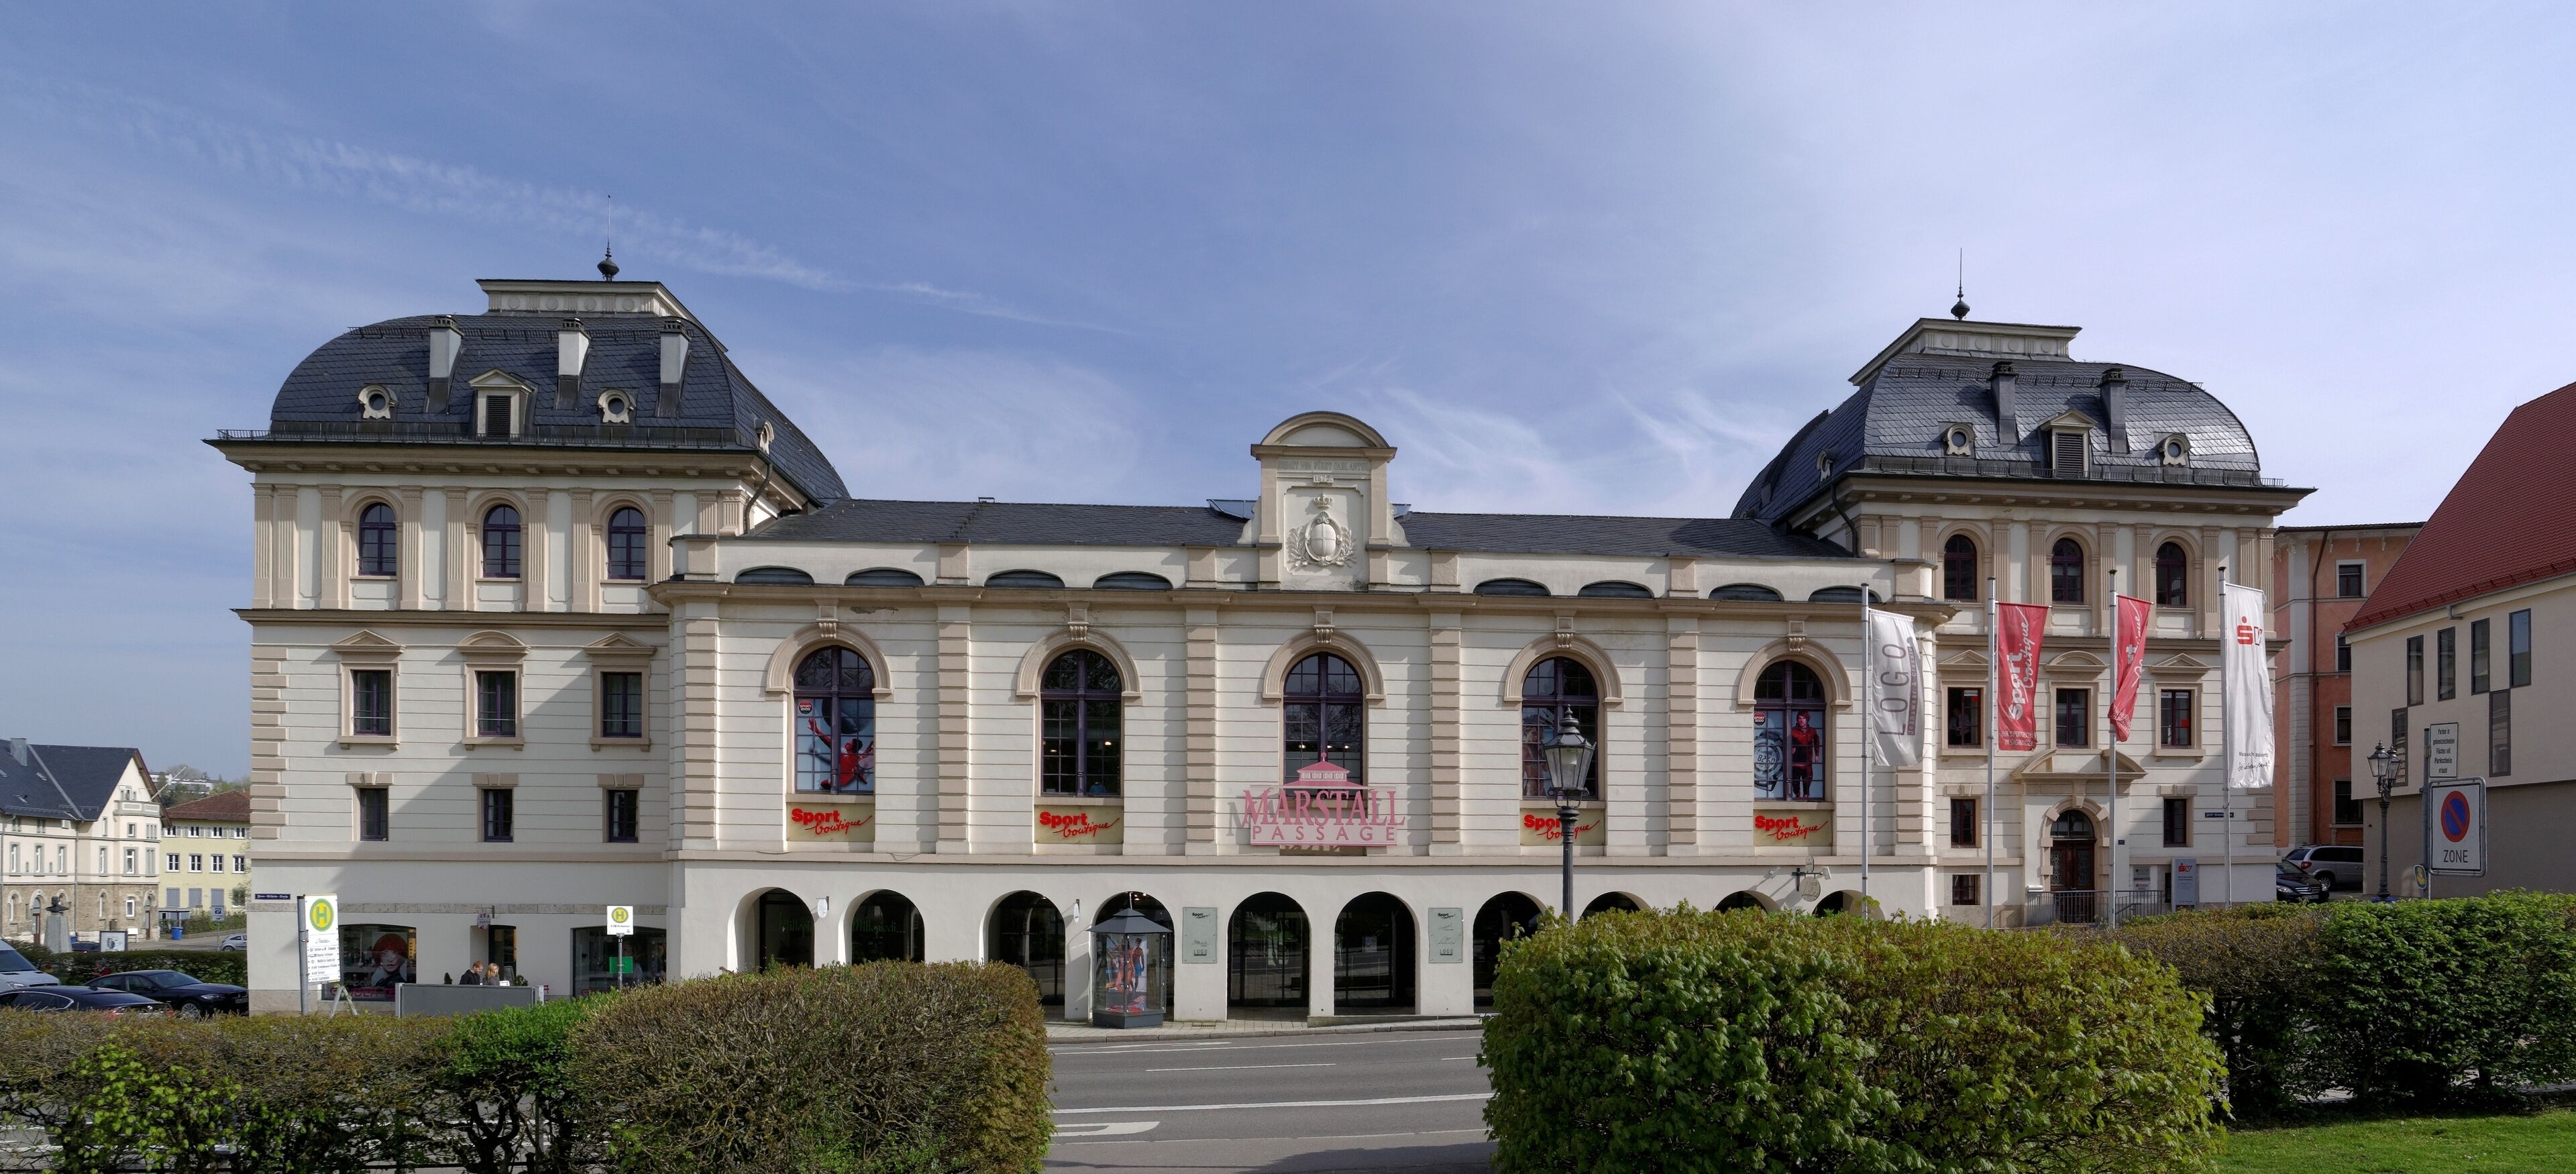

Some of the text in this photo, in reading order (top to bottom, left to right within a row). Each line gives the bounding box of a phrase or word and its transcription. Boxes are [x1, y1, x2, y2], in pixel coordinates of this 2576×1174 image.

[1880, 644, 1909, 735] LOGO
[1242, 787, 1406, 826] MARSTALL
[791, 808, 840, 825] Sport
[805, 815, 872, 835] boutique
[1040, 812, 1087, 828] Sport
[1523, 814, 1560, 831] Spor
[1755, 815, 1799, 831] Sport
[1053, 818, 1120, 837] boutique
[1252, 826, 1395, 841] PASSAGE
[1766, 821, 1828, 840] boutique
[2443, 849, 2469, 863] ZONE
[316, 906, 327, 924] H
